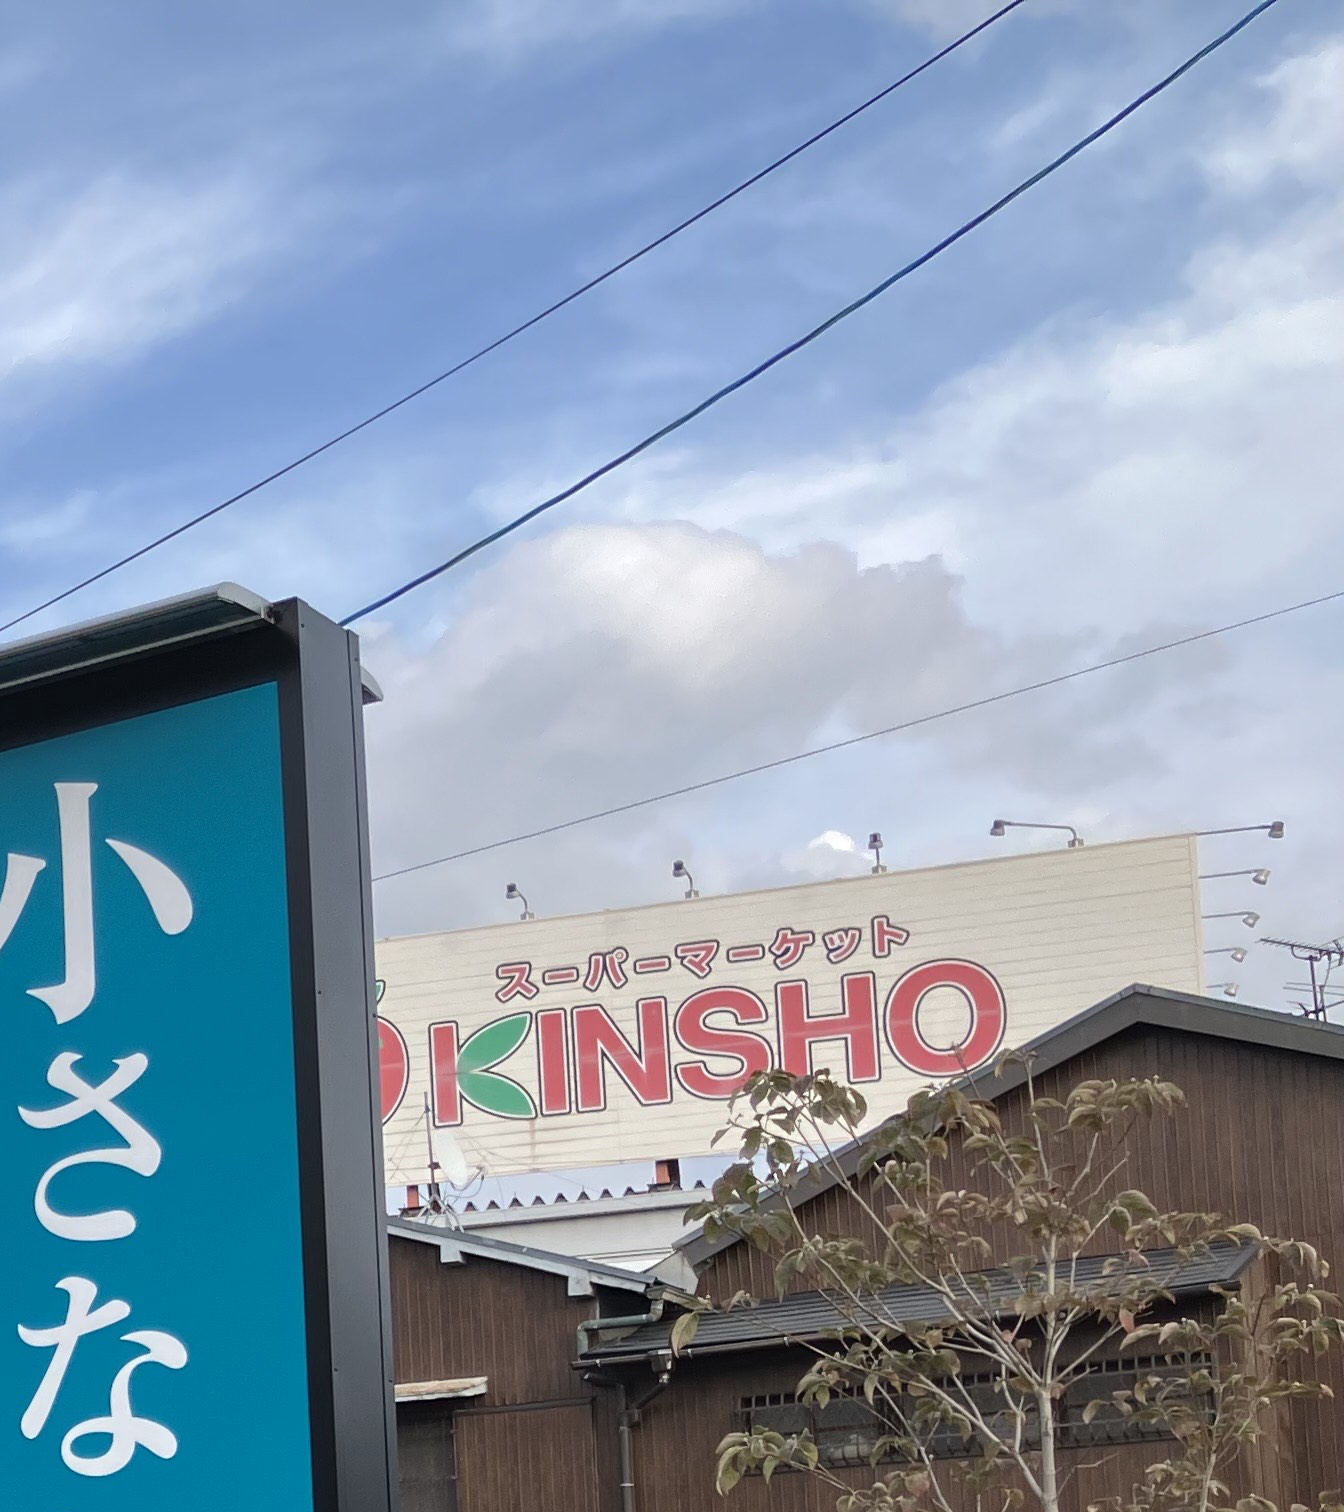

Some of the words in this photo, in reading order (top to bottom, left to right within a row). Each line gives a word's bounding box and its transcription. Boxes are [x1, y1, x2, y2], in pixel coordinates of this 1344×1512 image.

[495, 915, 910, 1003] スーパーマーケット
[428, 958, 1007, 1127] KINSHO
